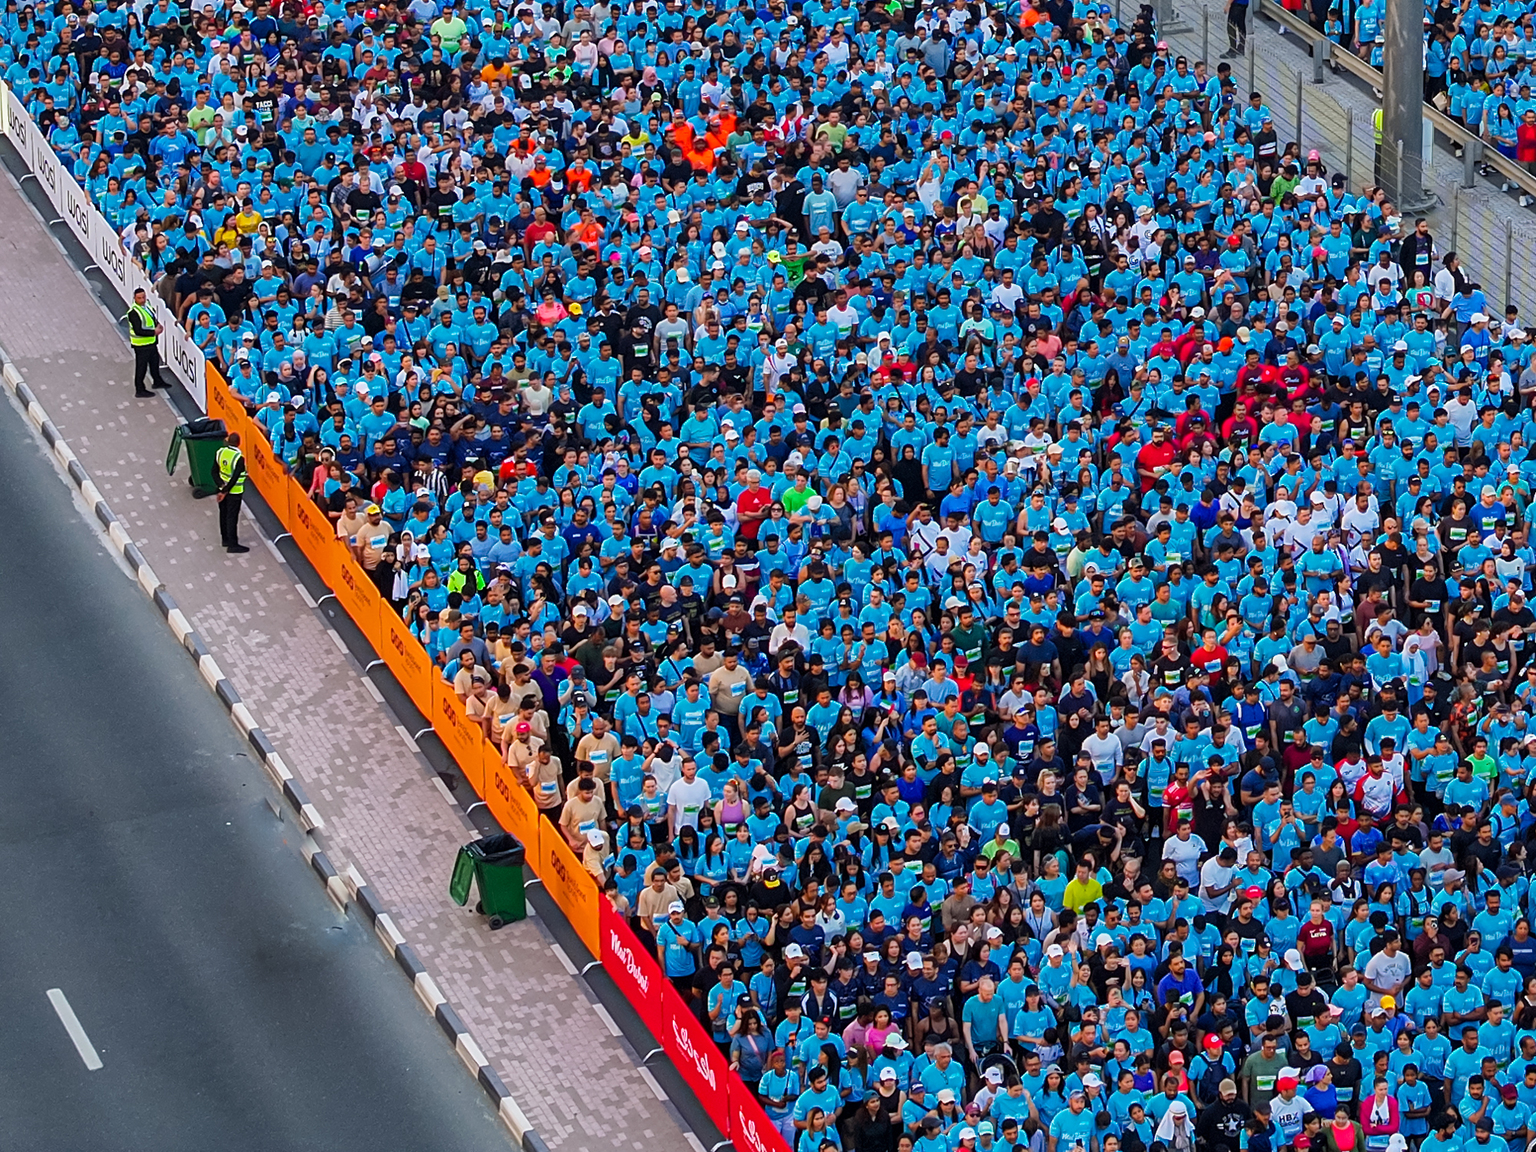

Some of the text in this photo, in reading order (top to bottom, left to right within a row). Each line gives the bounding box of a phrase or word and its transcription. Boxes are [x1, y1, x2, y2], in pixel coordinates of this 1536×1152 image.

[8, 107, 27, 150] wasl
[37, 147, 56, 195] wasl
[67, 190, 89, 239] wasl
[102, 236, 125, 286] wasl
[172, 335, 197, 388] wasl
